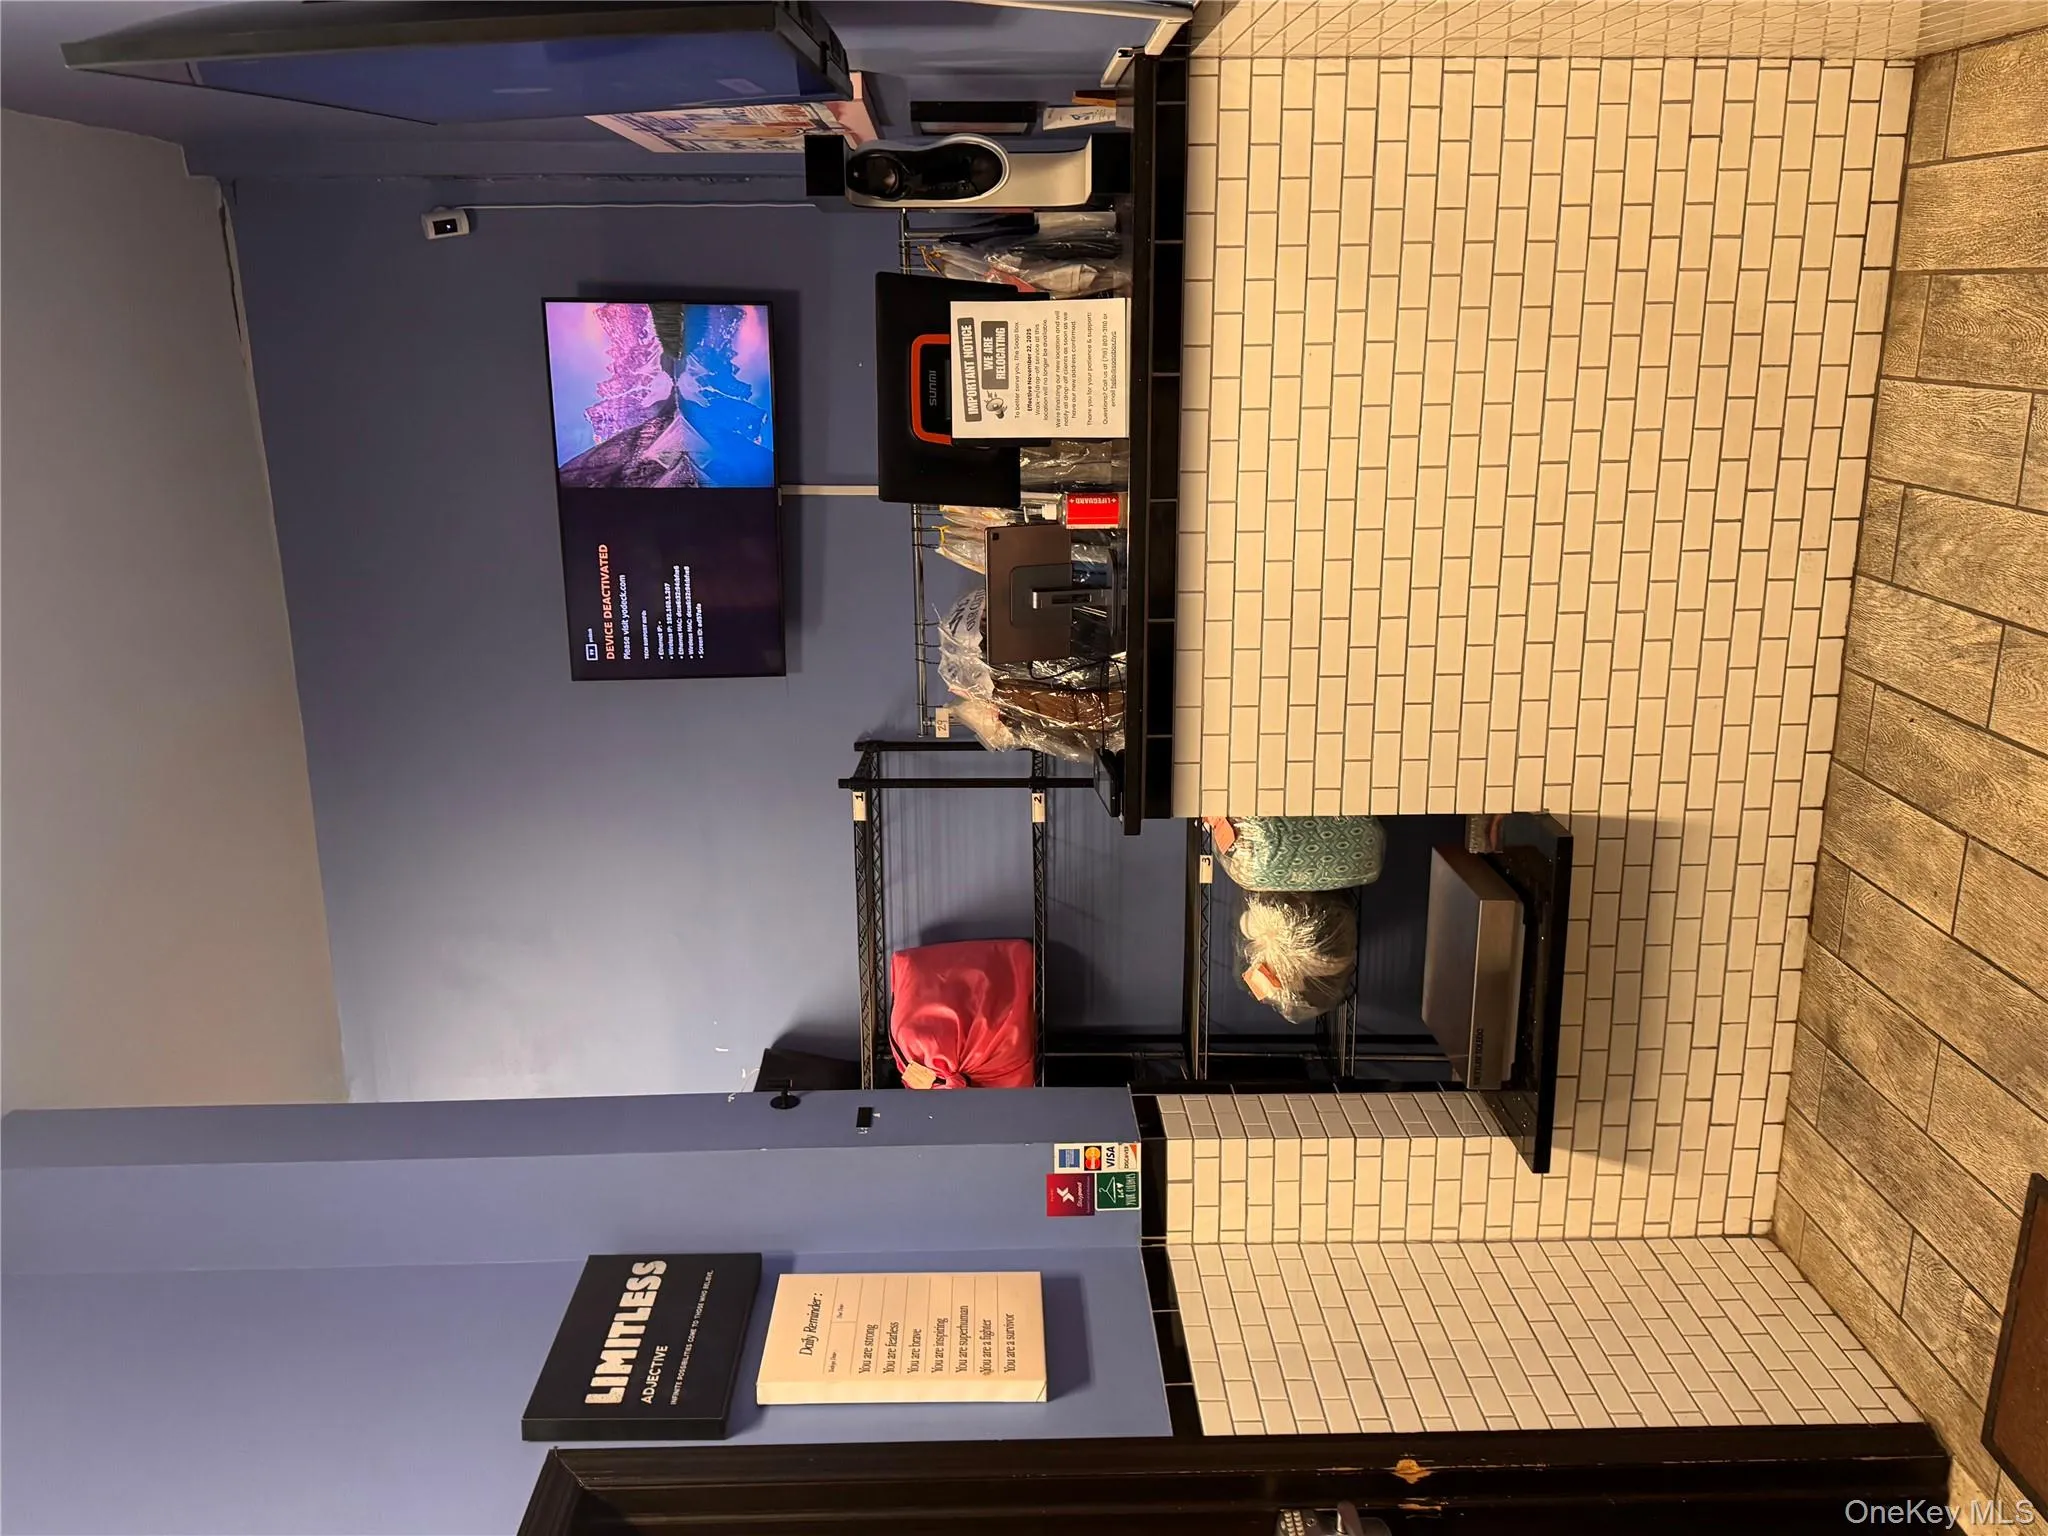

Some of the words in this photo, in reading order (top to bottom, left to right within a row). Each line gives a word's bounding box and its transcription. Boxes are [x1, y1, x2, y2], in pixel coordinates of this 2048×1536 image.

[1064, 312, 1067, 321] we
[961, 325, 974, 358] NOTICE
[983, 337, 993, 353] ARE
[996, 328, 1006, 379] RELOCATING
[984, 356, 993, 370] WE
[964, 361, 979, 414] IMPORTANT
[599, 544, 612, 618] DEACTIVATED
[619, 575, 630, 618] yodeck.com
[604, 622, 614, 659] DEVICE
[937, 720, 948, 732] 29
[855, 793, 864, 802] 1
[1034, 795, 1041, 804] 2
[1202, 857, 1210, 866] 3
[1106, 1146, 1115, 1167] VISA
[698, 1290, 708, 1302] WHO
[694, 1303, 704, 1318] THOSE
[585, 1261, 667, 1403] LIMITLESS
[933, 1318, 948, 1346] inspiring
[956, 1306, 971, 1346] superhuman
[979, 1319, 994, 1340] fighter
[1004, 1314, 1014, 1340] survivor
[688, 1329, 697, 1342] COME
[864, 1324, 878, 1346] strong
[884, 1322, 899, 1347] fearless
[908, 1329, 921, 1347] brave
[799, 1334, 819, 1356] Daily
[864, 1348, 872, 1359] are
[887, 1348, 896, 1359] are
[911, 1348, 920, 1359] are
[935, 1348, 944, 1358] are
[959, 1347, 967, 1358] are
[983, 1347, 991, 1358] are
[1006, 1347, 1015, 1358] are
[677, 1344, 692, 1380] POSSIBILITIES
[859, 1360, 871, 1373] You
[883, 1361, 895, 1373] You
[907, 1361, 920, 1373] You
[932, 1360, 944, 1373] You
[956, 1360, 967, 1373] You
[980, 1359, 991, 1373] You
[1004, 1359, 1015, 1373] You
[640, 1345, 668, 1404] ADJECTIVE
[670, 1382, 682, 1405] INFINITE
